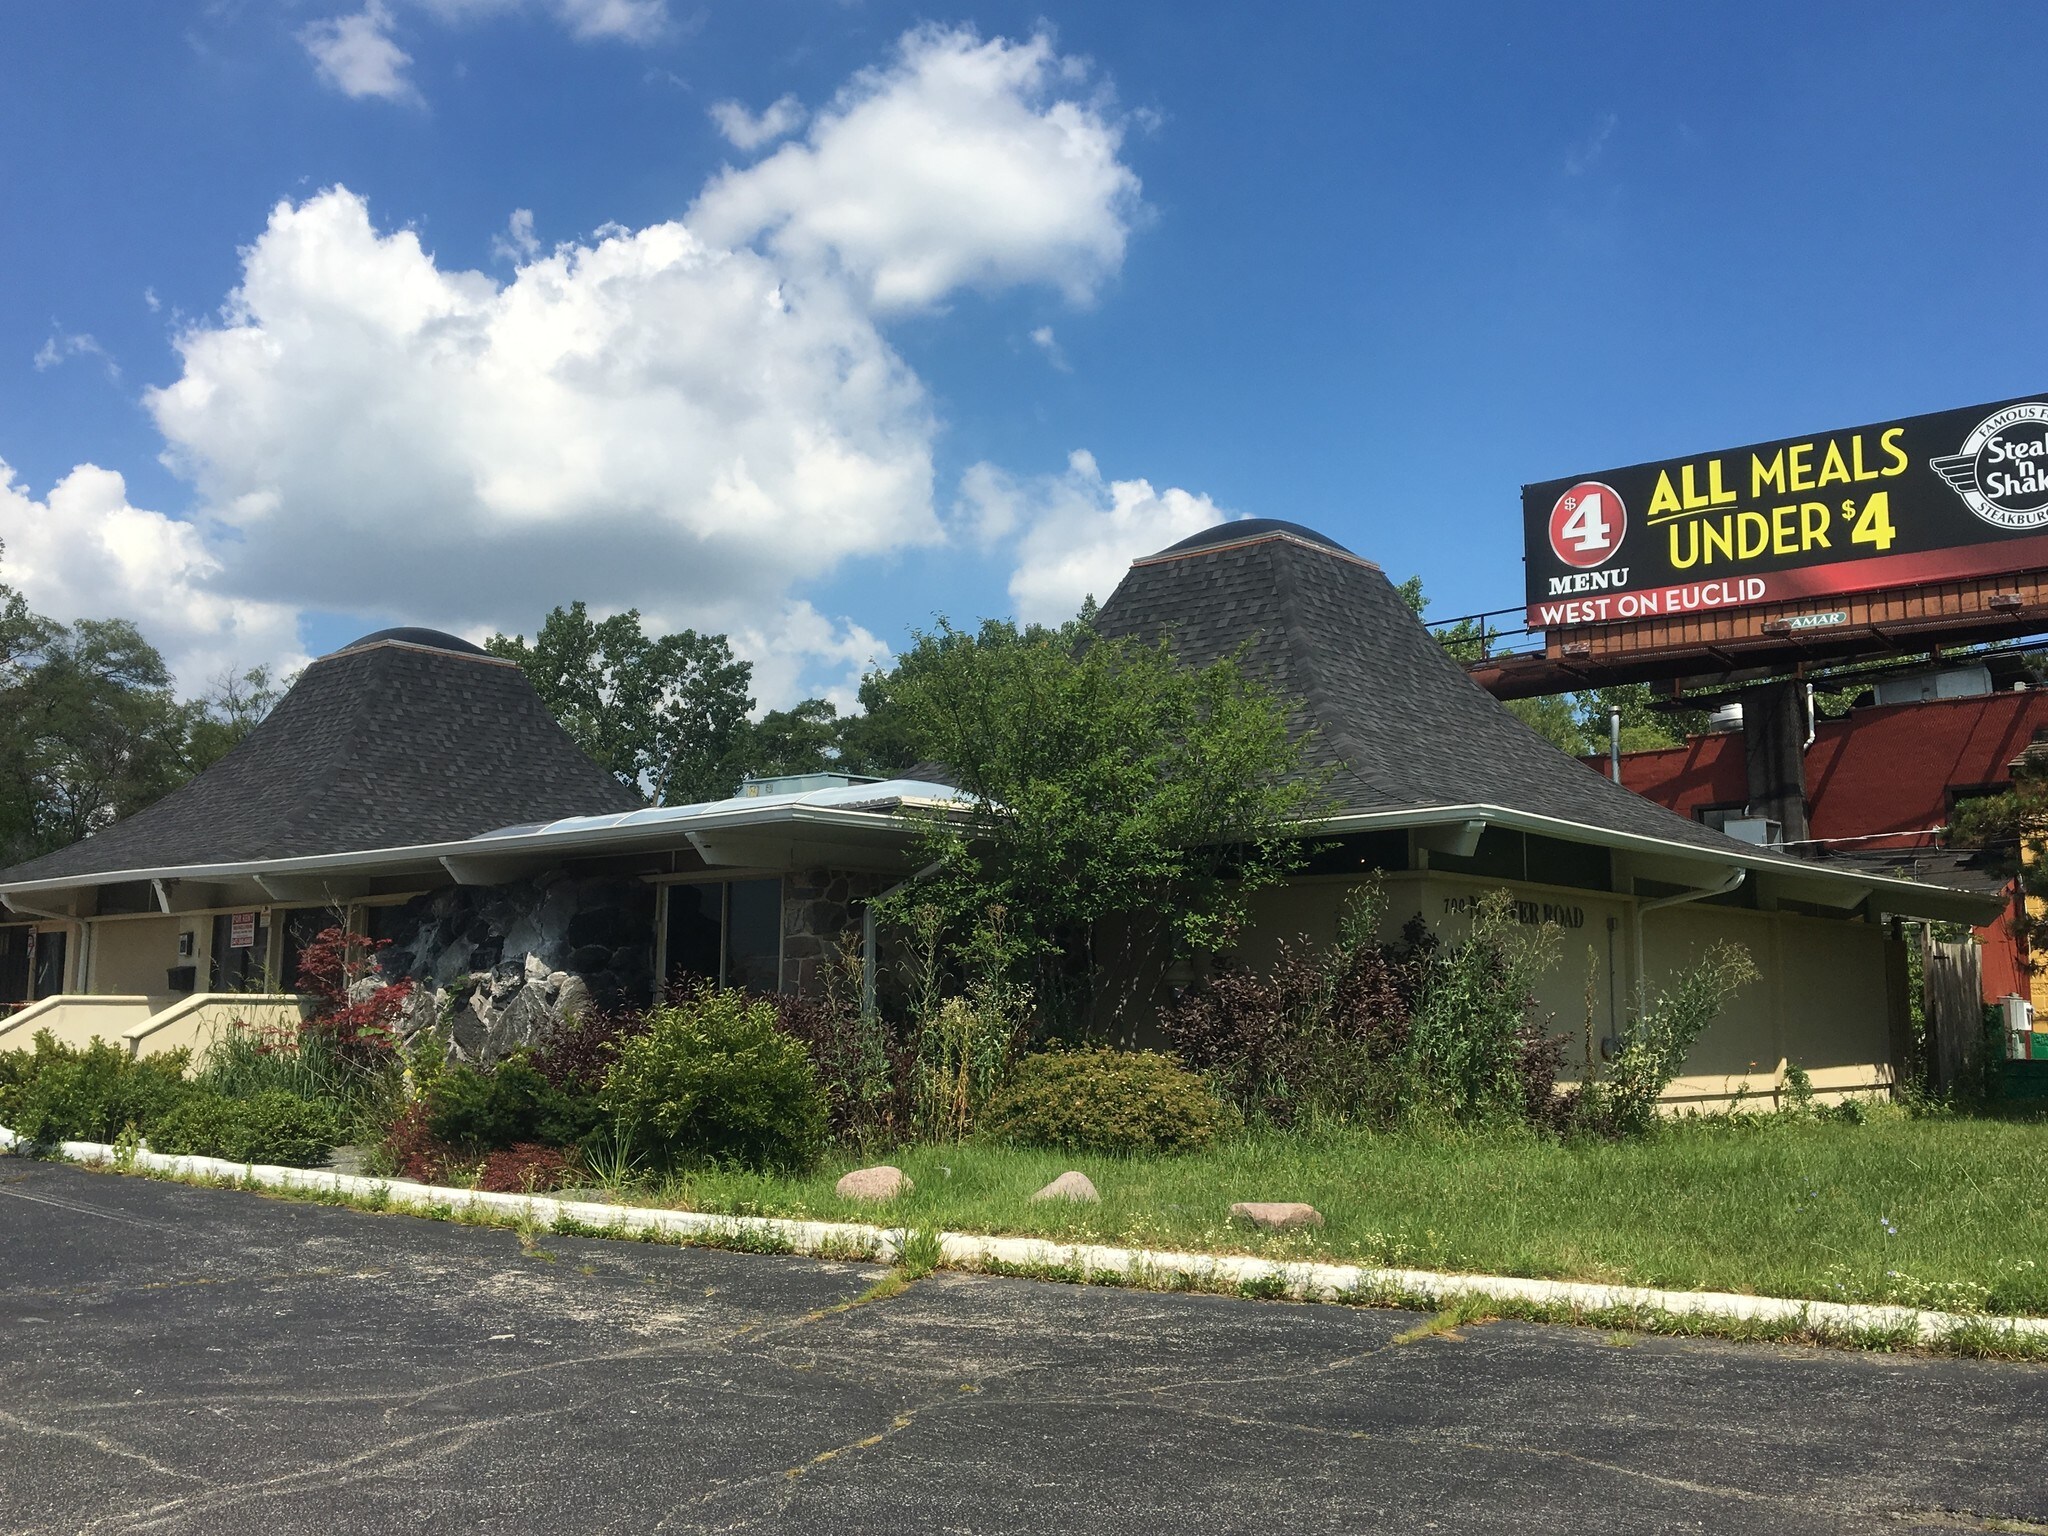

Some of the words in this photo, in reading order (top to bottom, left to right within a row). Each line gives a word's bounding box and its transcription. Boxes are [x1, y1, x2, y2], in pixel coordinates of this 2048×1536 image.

[1979, 407, 2036, 437] FAMOUS
[1647, 459, 1737, 515] ALL
[1751, 428, 1909, 498] MEALS
[1562, 493, 1611, 552] $4
[1669, 501, 1833, 569] UNDER
[1841, 492, 1896, 551] $4
[1540, 598, 1610, 625] WEST
[1618, 592, 1658, 617] ON
[1666, 577, 1767, 612] EUCLID
[1549, 568, 1630, 596] MENU
[1791, 613, 1840, 628] AMAR
[1544, 903, 1585, 929] ROAD
